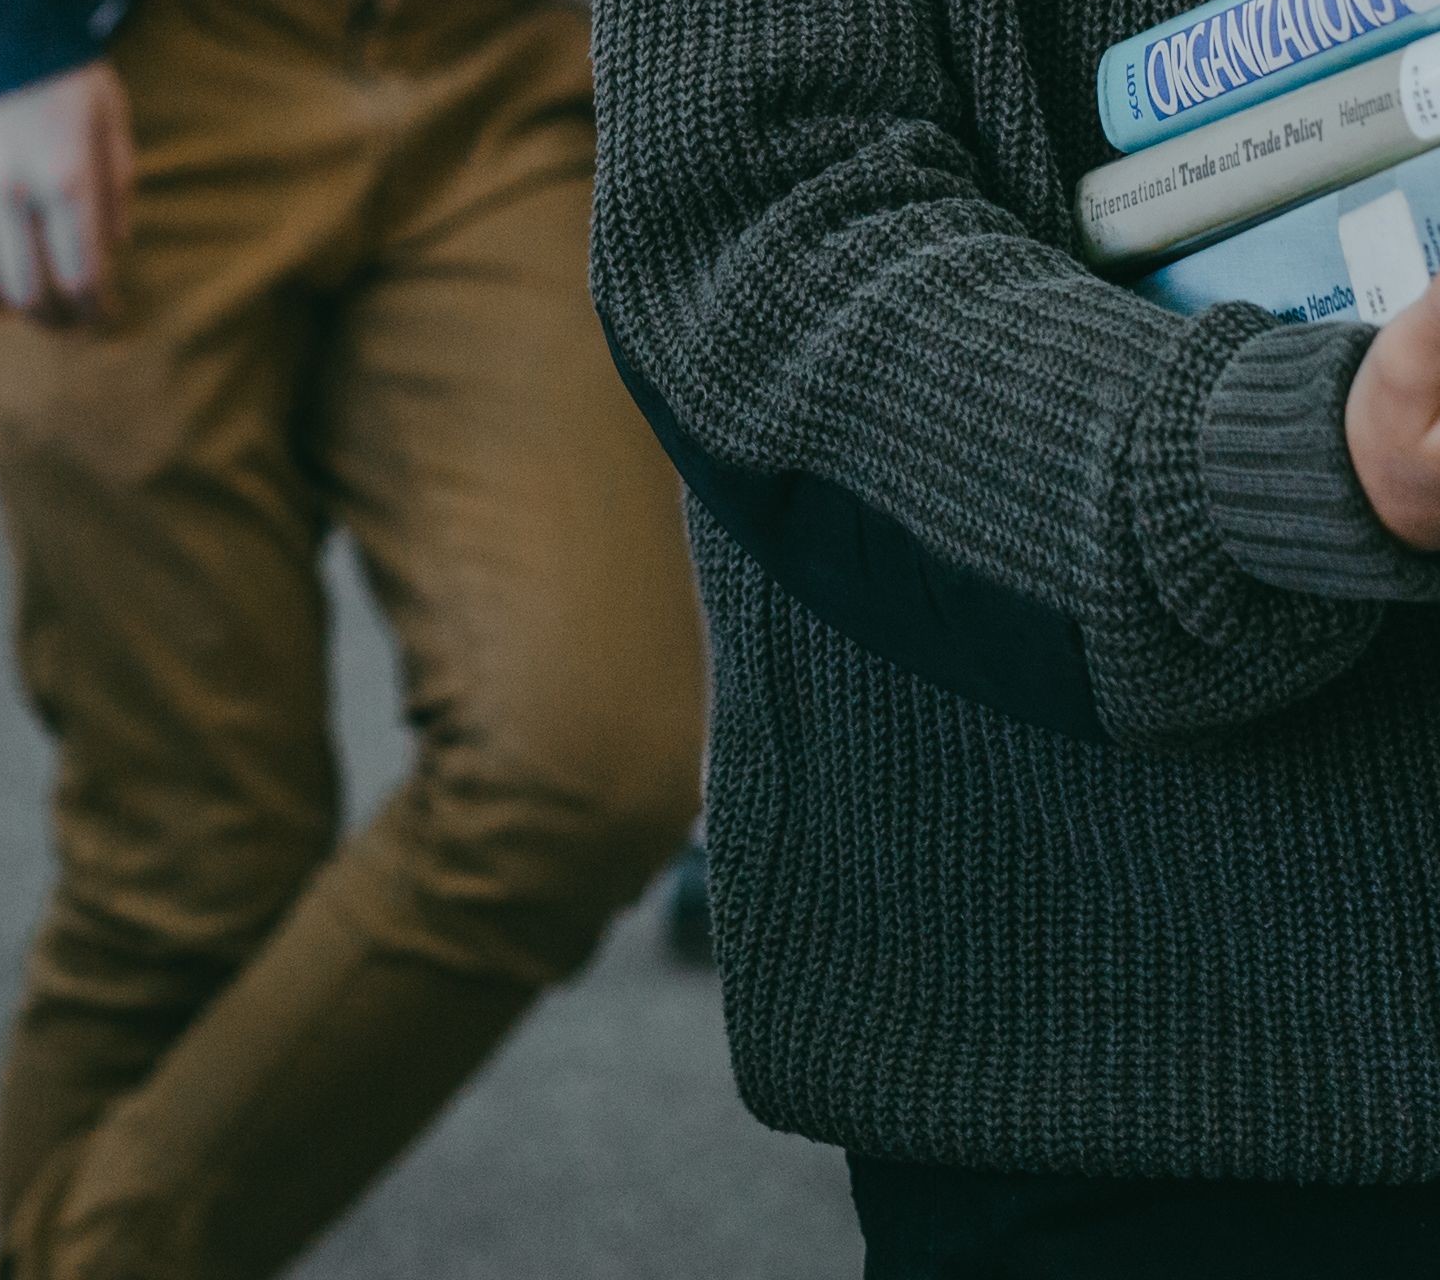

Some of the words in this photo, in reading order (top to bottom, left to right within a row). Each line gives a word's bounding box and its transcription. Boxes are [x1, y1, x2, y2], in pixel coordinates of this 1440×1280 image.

[1126, 63, 1143, 120] SCOTT
[1090, 168, 1177, 222] International
[1179, 155, 1216, 186] Trade
[1219, 143, 1240, 172] and
[1242, 132, 1281, 163] Trade
[1284, 119, 1323, 148] Policy
[1338, 91, 1395, 127] Helpman
[1307, 285, 1357, 321] Handbo
